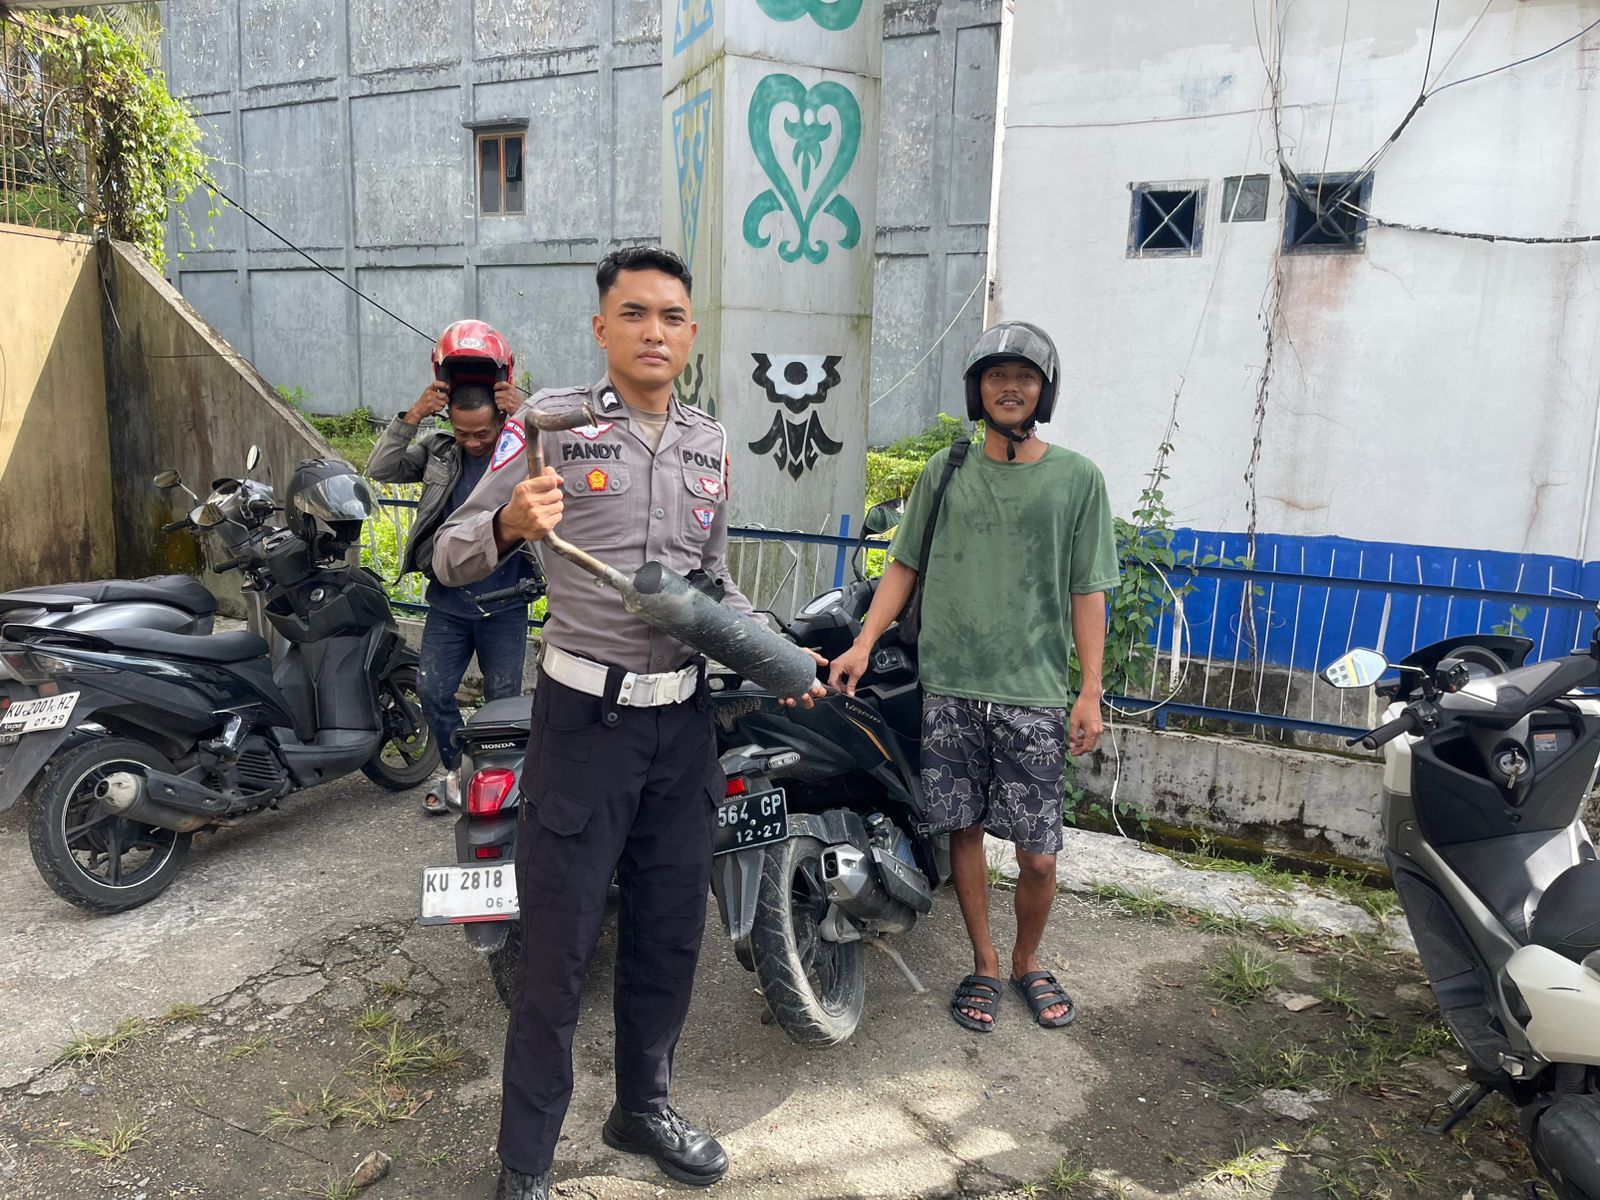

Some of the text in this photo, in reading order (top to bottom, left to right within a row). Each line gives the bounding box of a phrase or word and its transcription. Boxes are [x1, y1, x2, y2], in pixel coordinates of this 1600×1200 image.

[562, 442, 622, 461] FANDY
[682, 449, 722, 473] POLR
[6, 695, 75, 718] KU 2001 HZ
[480, 741, 517, 750] HONDA
[760, 794, 782, 816] GP
[426, 869, 503, 893] KU 2818
